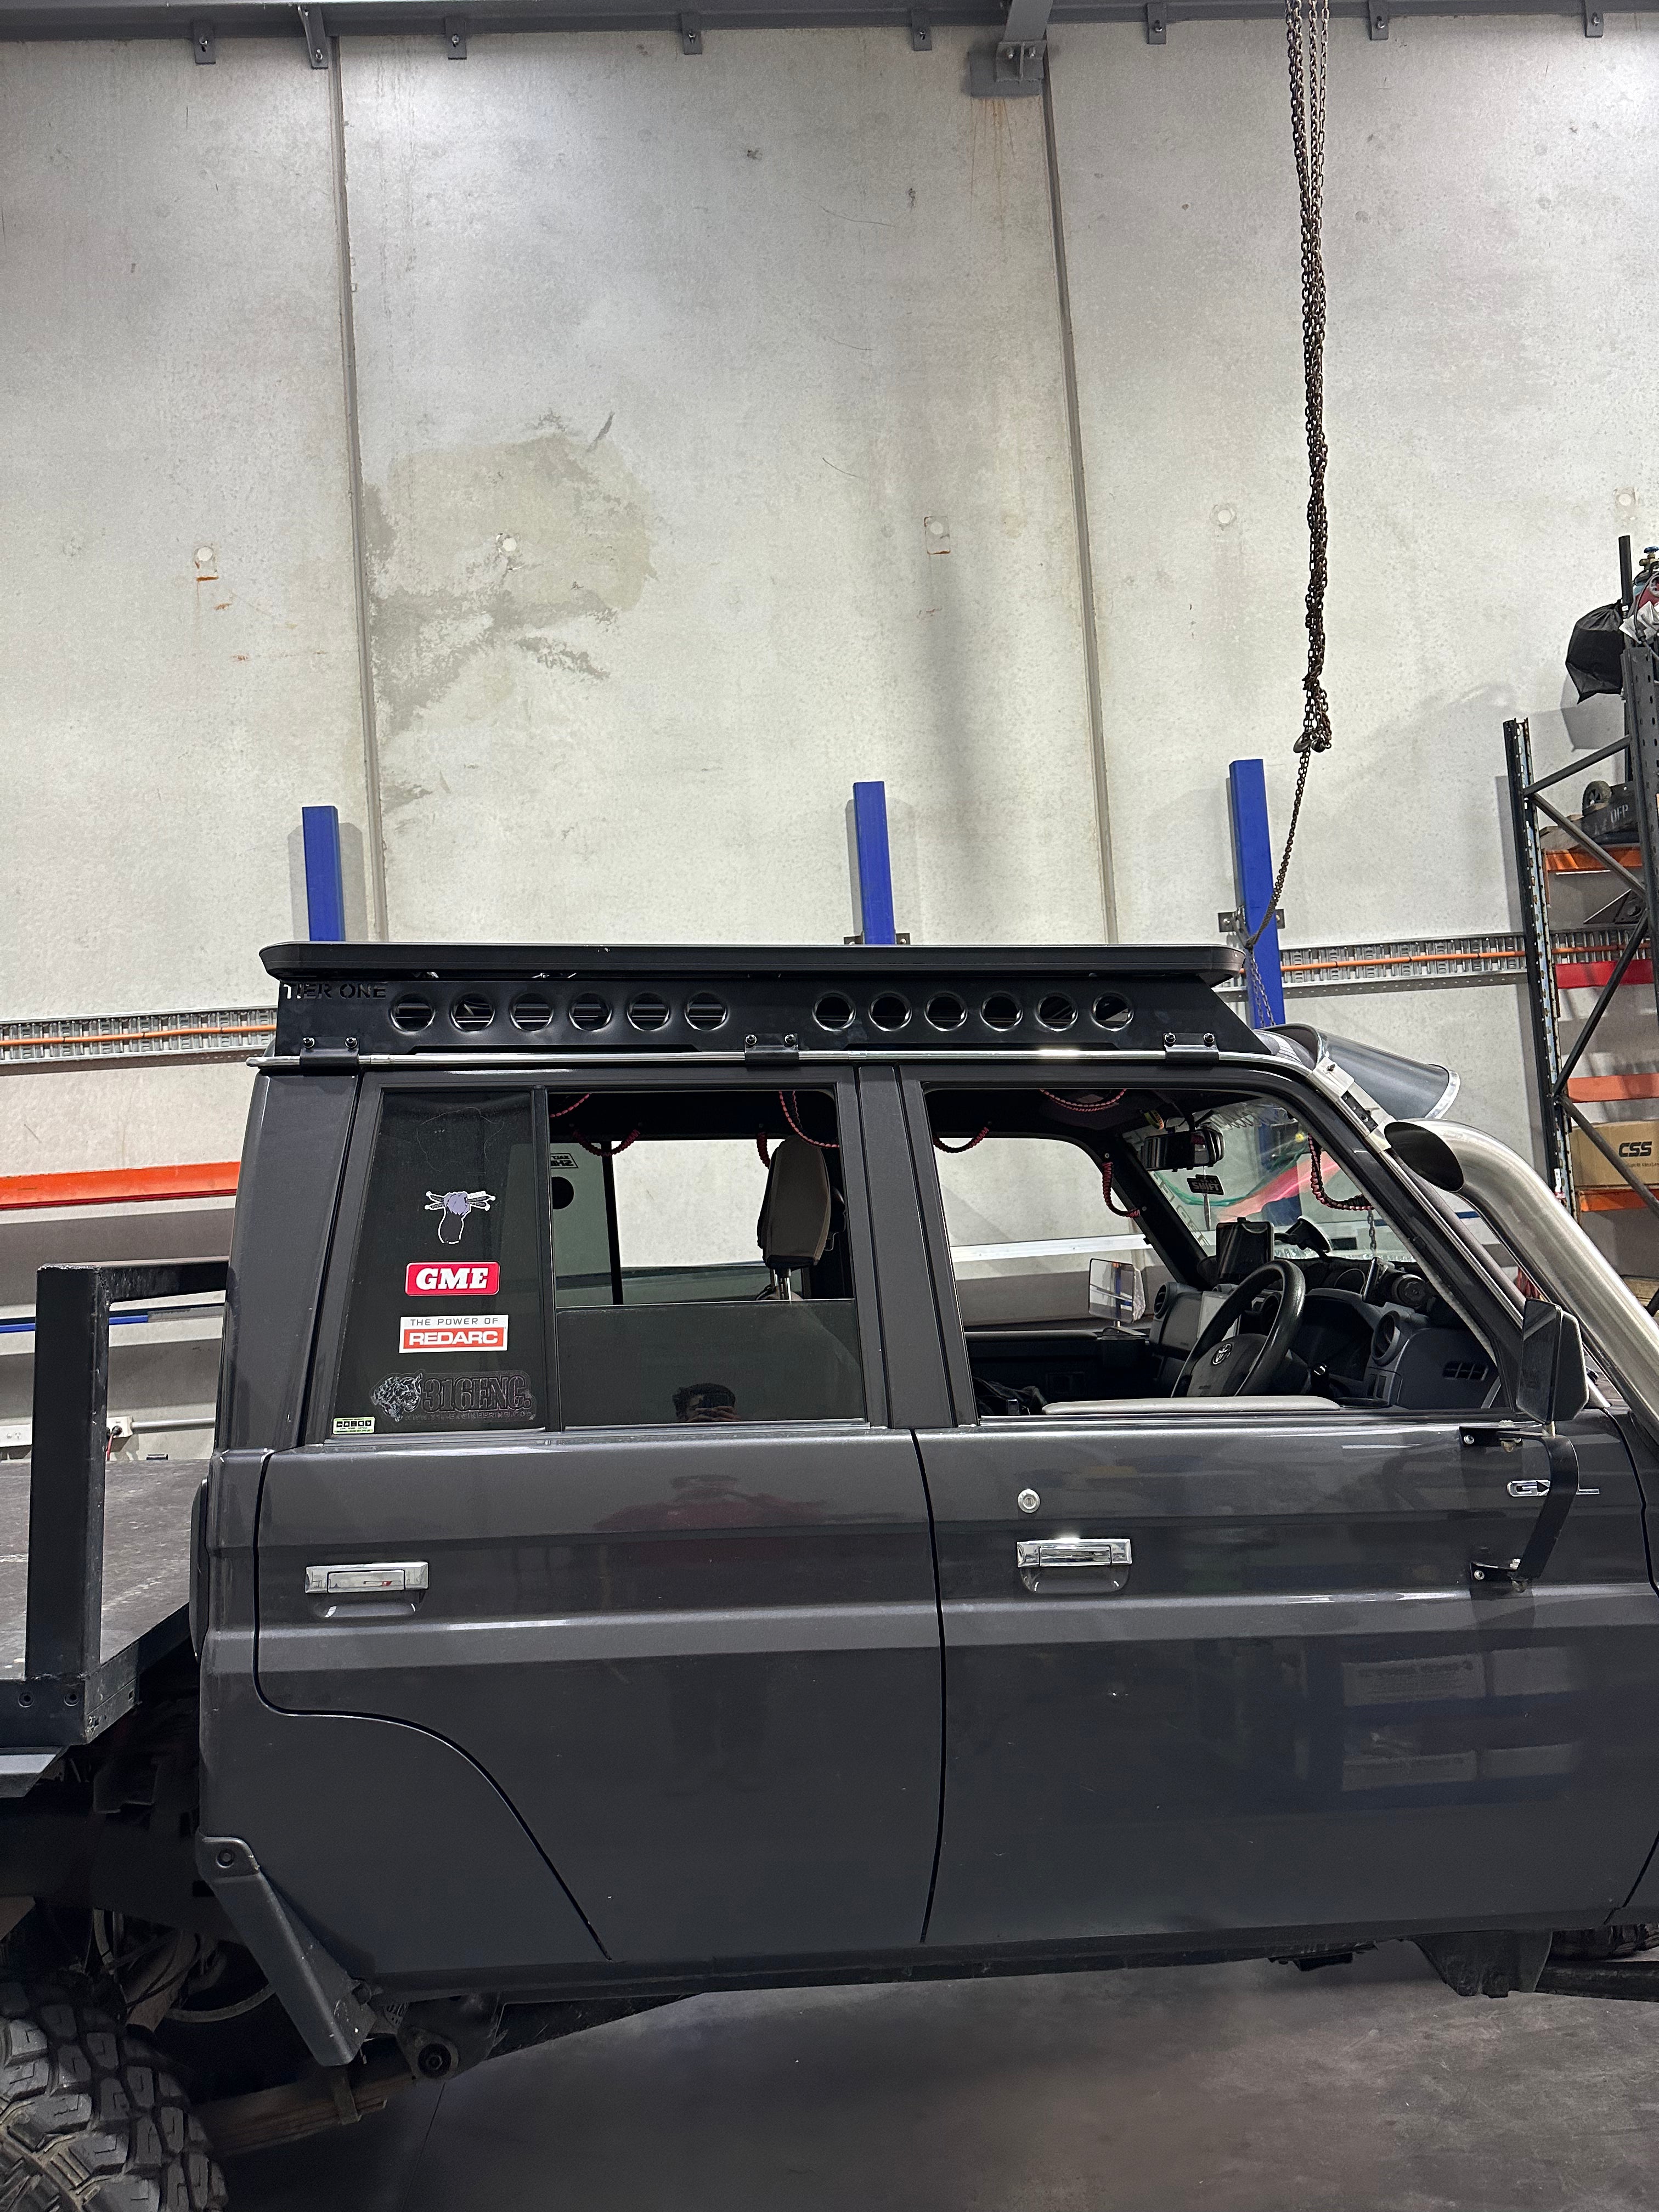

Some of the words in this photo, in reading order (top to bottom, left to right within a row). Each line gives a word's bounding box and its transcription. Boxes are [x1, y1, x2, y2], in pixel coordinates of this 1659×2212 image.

[283, 983, 332, 999] TIER
[339, 982, 386, 999] ONE
[1618, 1141, 1653, 1158] CSS
[415, 1267, 489, 1290] GME
[409, 1330, 499, 1346] REDARC
